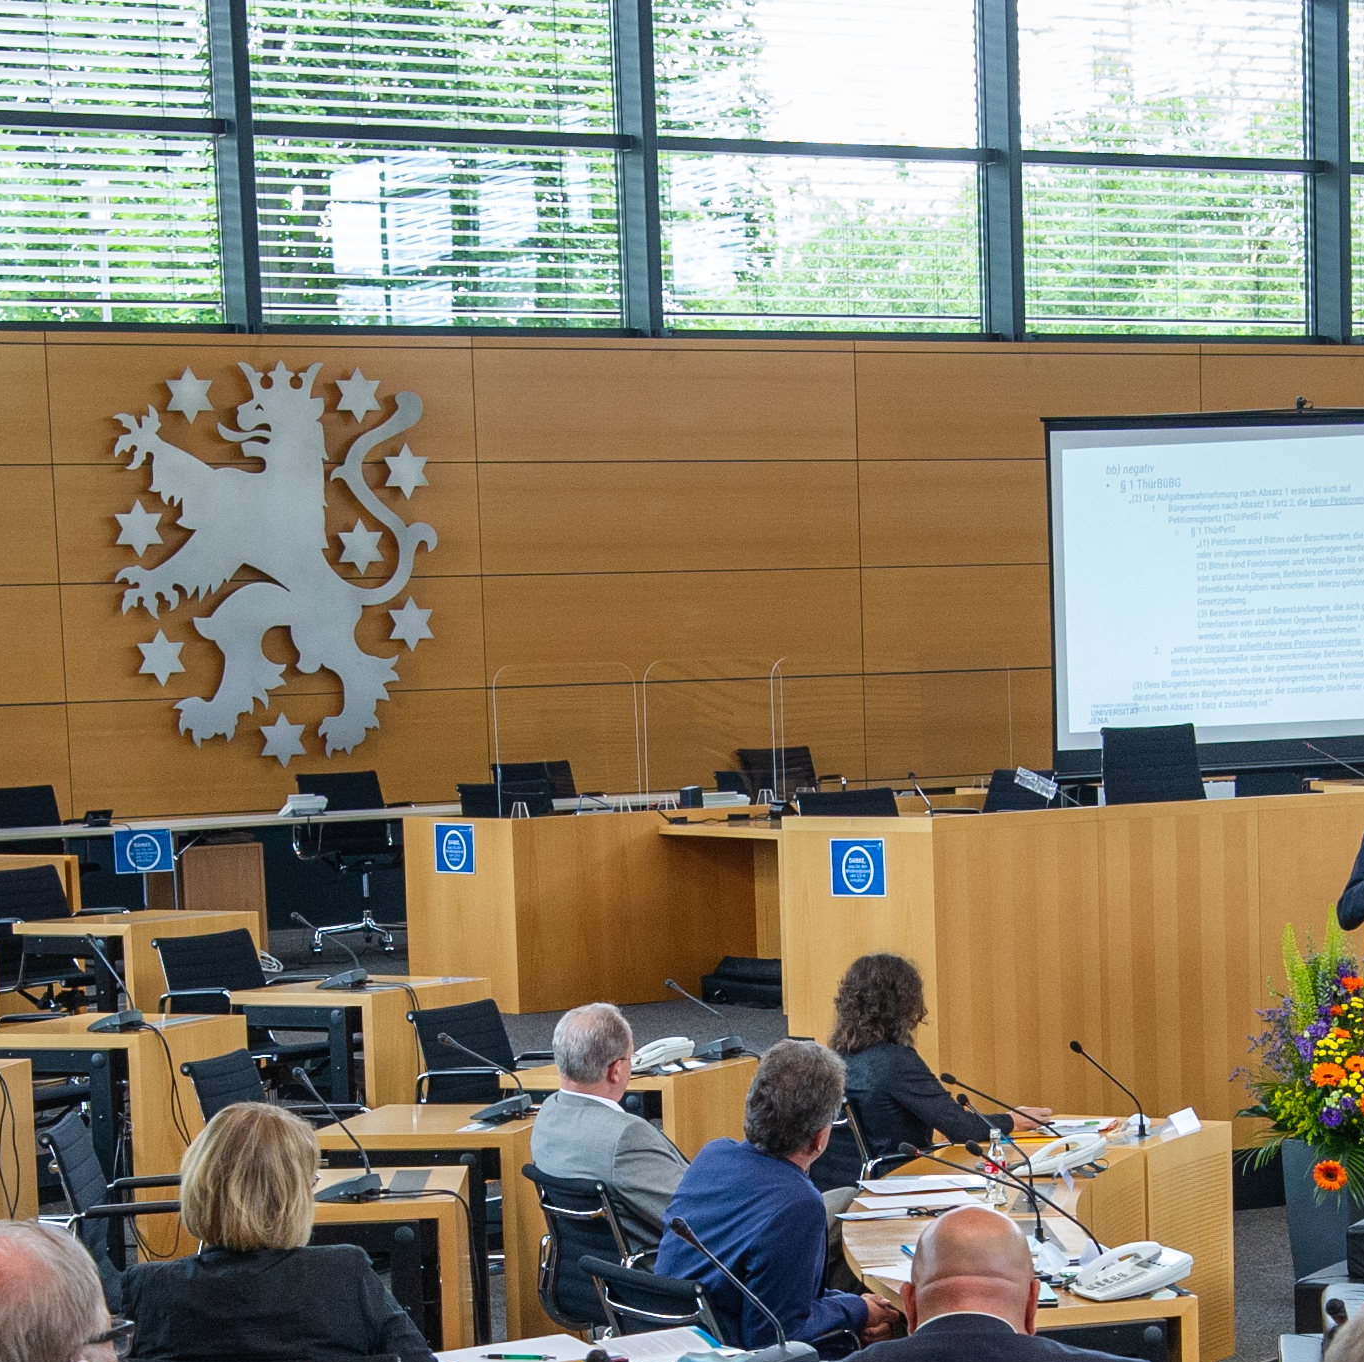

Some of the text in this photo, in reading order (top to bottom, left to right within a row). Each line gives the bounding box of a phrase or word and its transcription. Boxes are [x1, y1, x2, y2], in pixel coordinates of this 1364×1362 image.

[1105, 463, 1154, 477] bb) negativ
[1137, 478, 1181, 489] ThürBüBG
